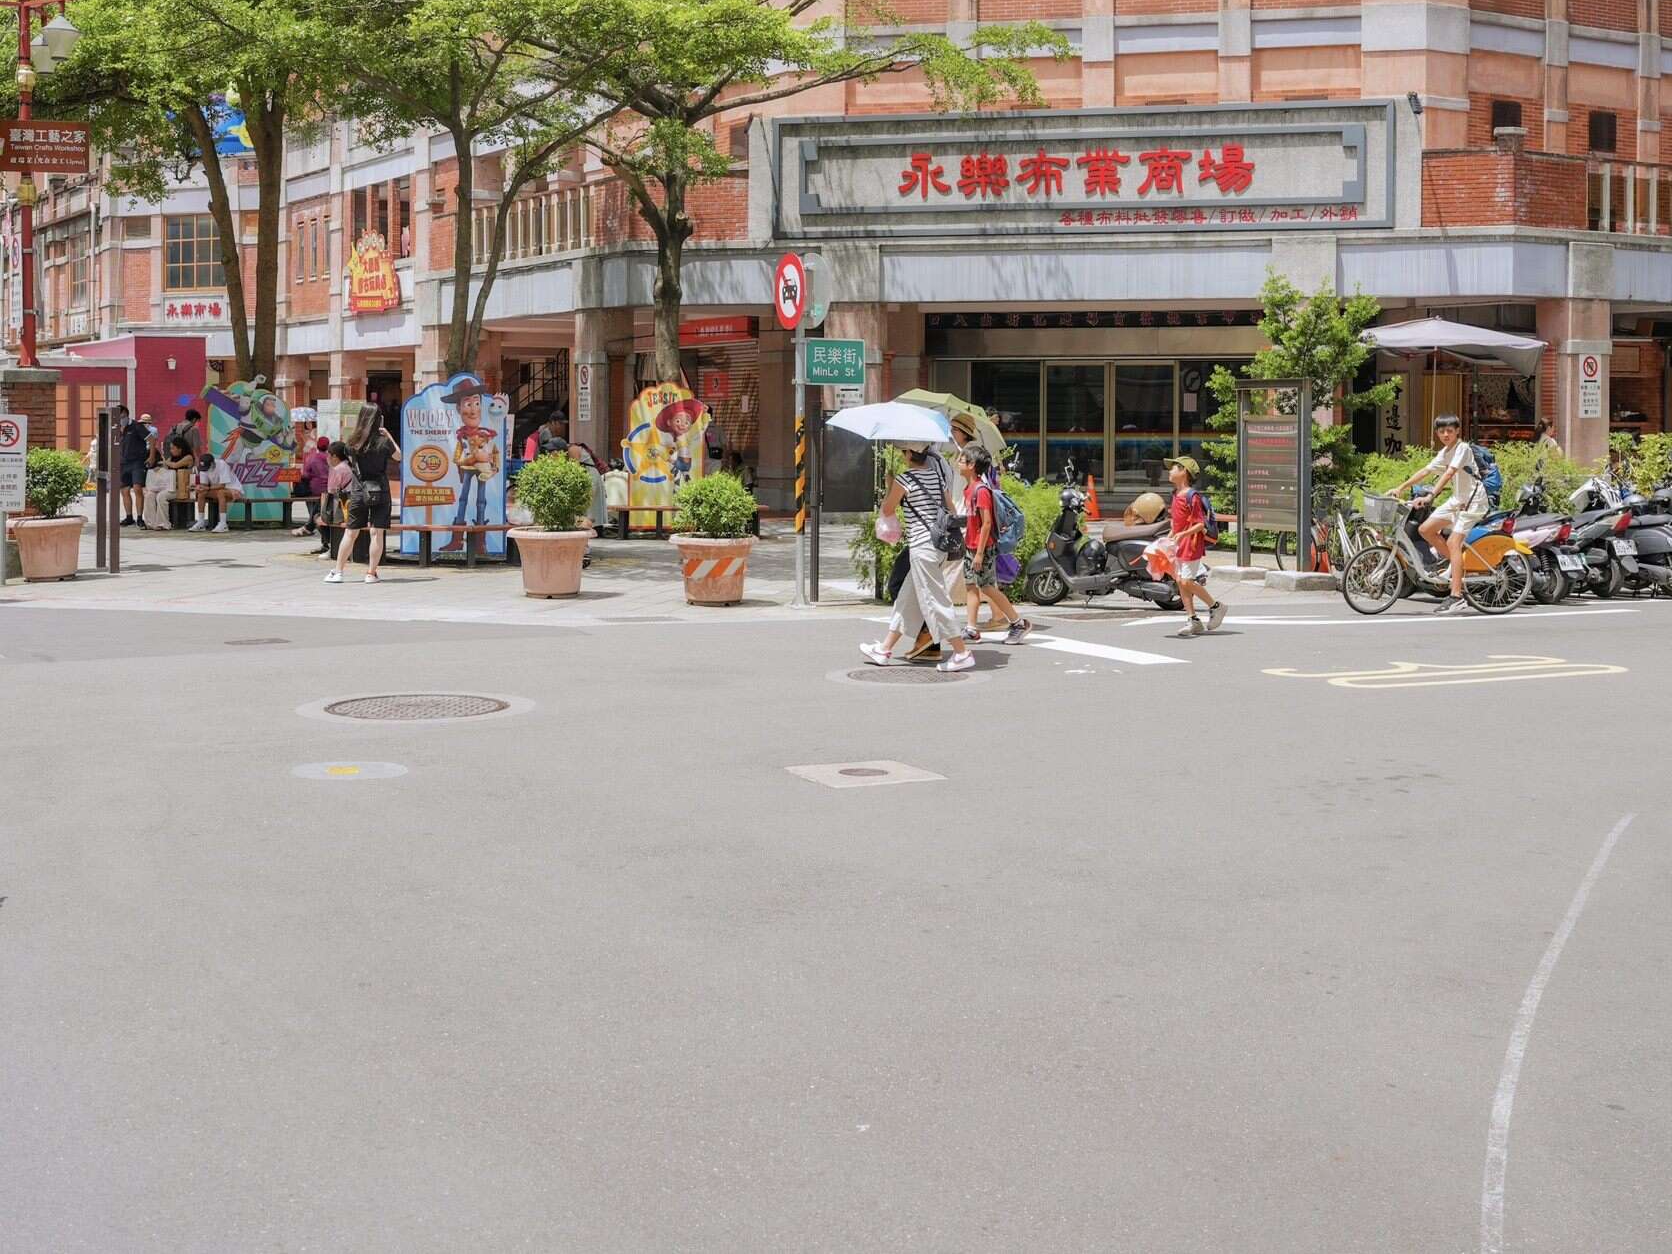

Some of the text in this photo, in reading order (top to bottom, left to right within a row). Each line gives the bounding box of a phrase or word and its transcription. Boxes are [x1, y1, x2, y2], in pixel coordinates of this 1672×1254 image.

[898, 142, 1256, 198] 永樂布業商場
[813, 346, 857, 365] 民樂街
[813, 366, 839, 378] MinLe
[406, 409, 454, 428] WOODY
